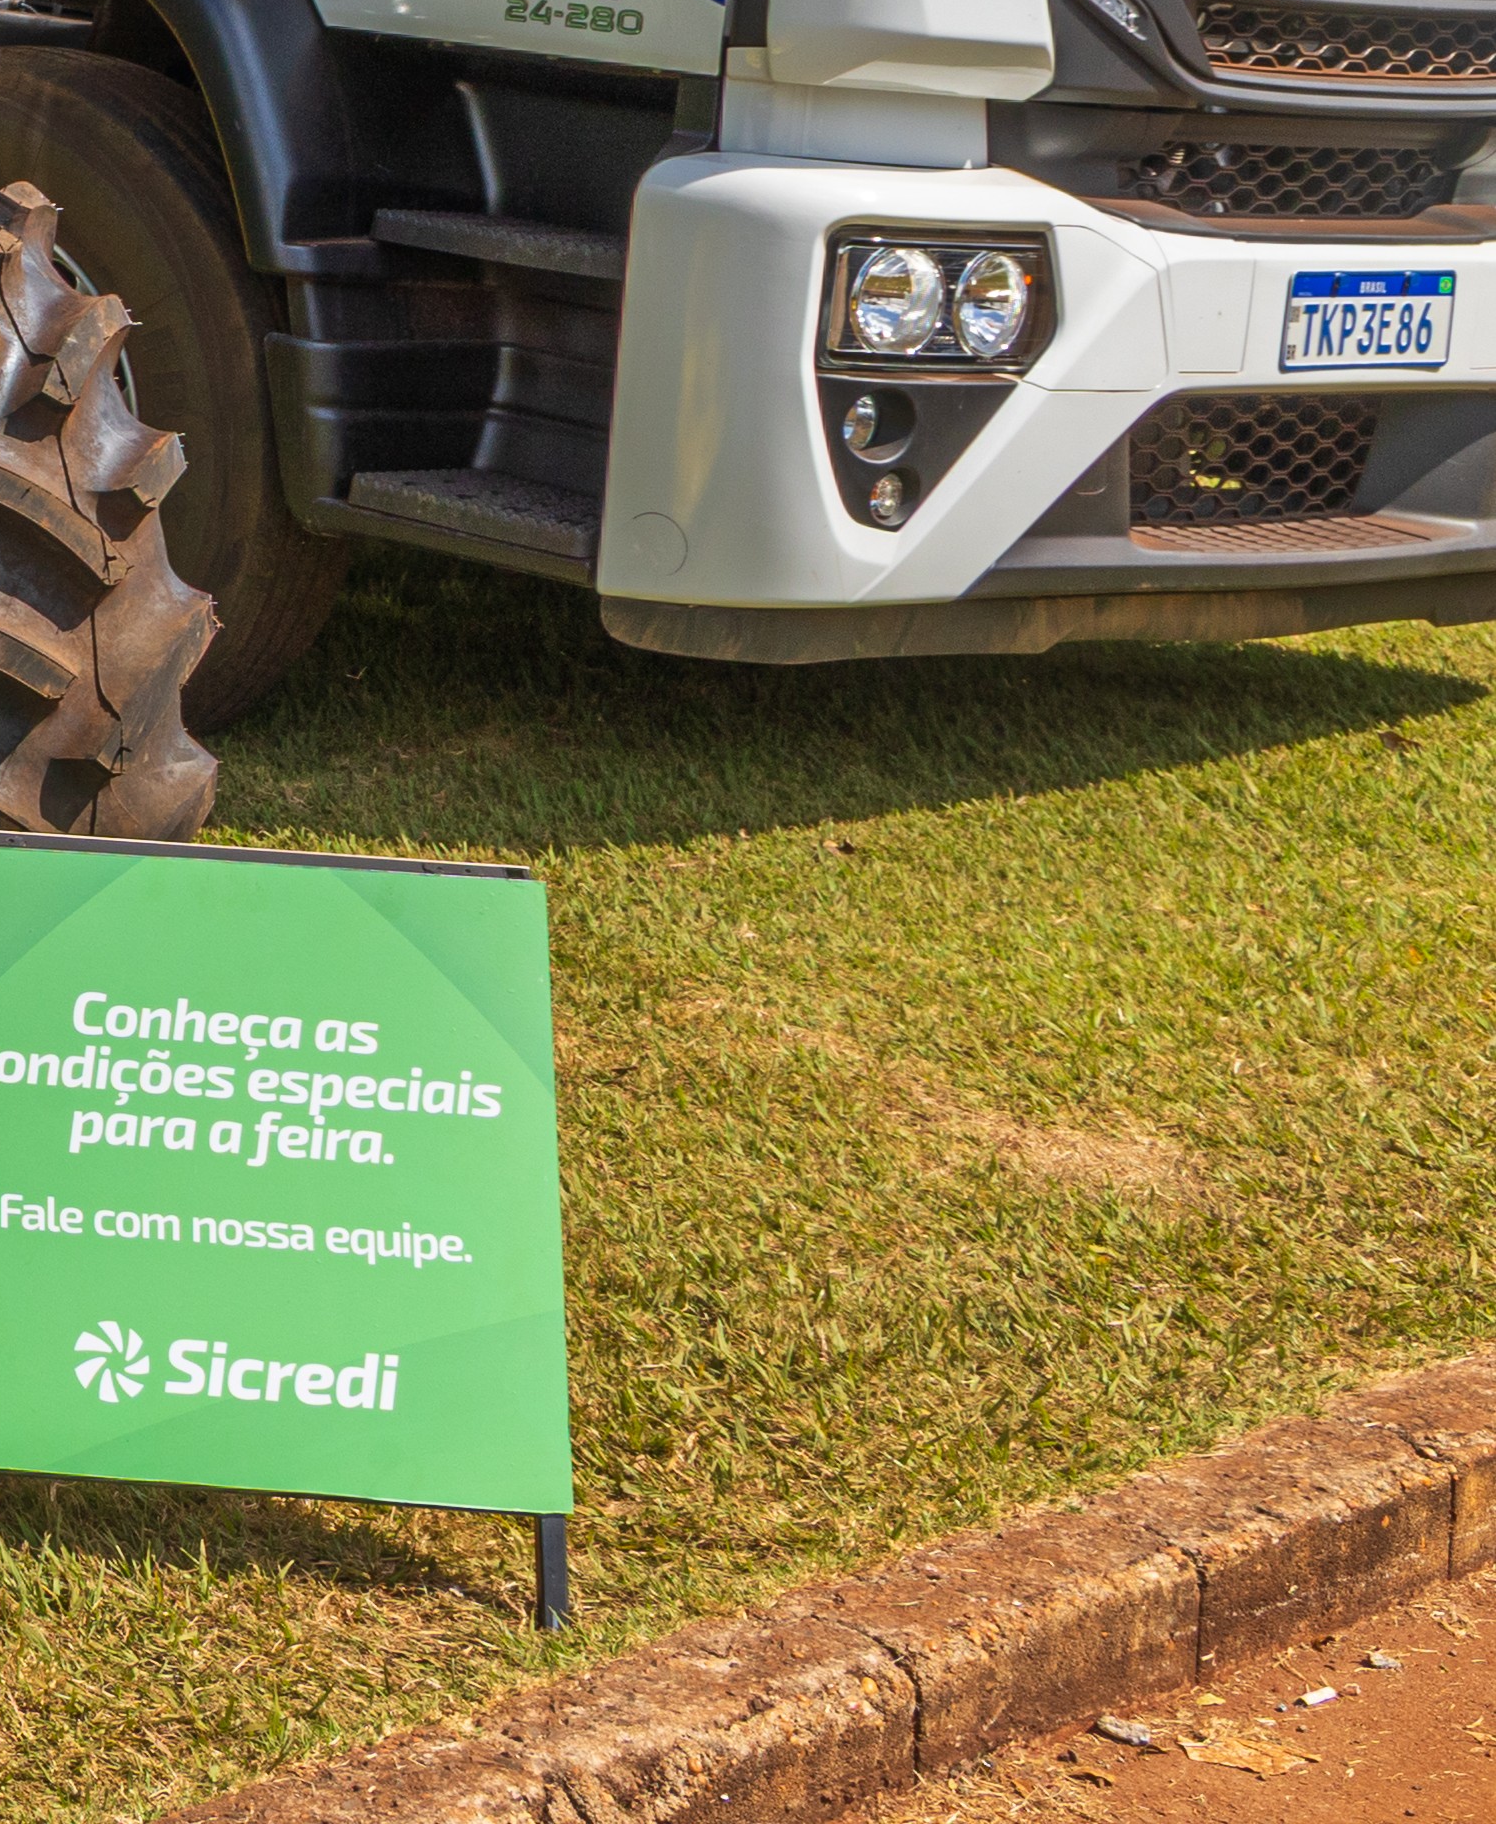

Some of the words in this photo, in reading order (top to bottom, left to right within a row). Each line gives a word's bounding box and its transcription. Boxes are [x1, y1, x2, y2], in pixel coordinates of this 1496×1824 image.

[1360, 281, 1387, 294] BRASIL
[1302, 302, 1433, 357] TKP3E86
[72, 991, 303, 1062] Conheça
[314, 1018, 380, 1055] as
[247, 1066, 504, 1119] especiais
[68, 1103, 197, 1154] para
[208, 1119, 243, 1155] a
[246, 1115, 396, 1168] feira.
[0, 1192, 85, 1236] Fale
[92, 1208, 182, 1243] com
[192, 1216, 316, 1252] nossa
[324, 1221, 474, 1271] equipe.
[164, 1337, 400, 1413] Sicredi
